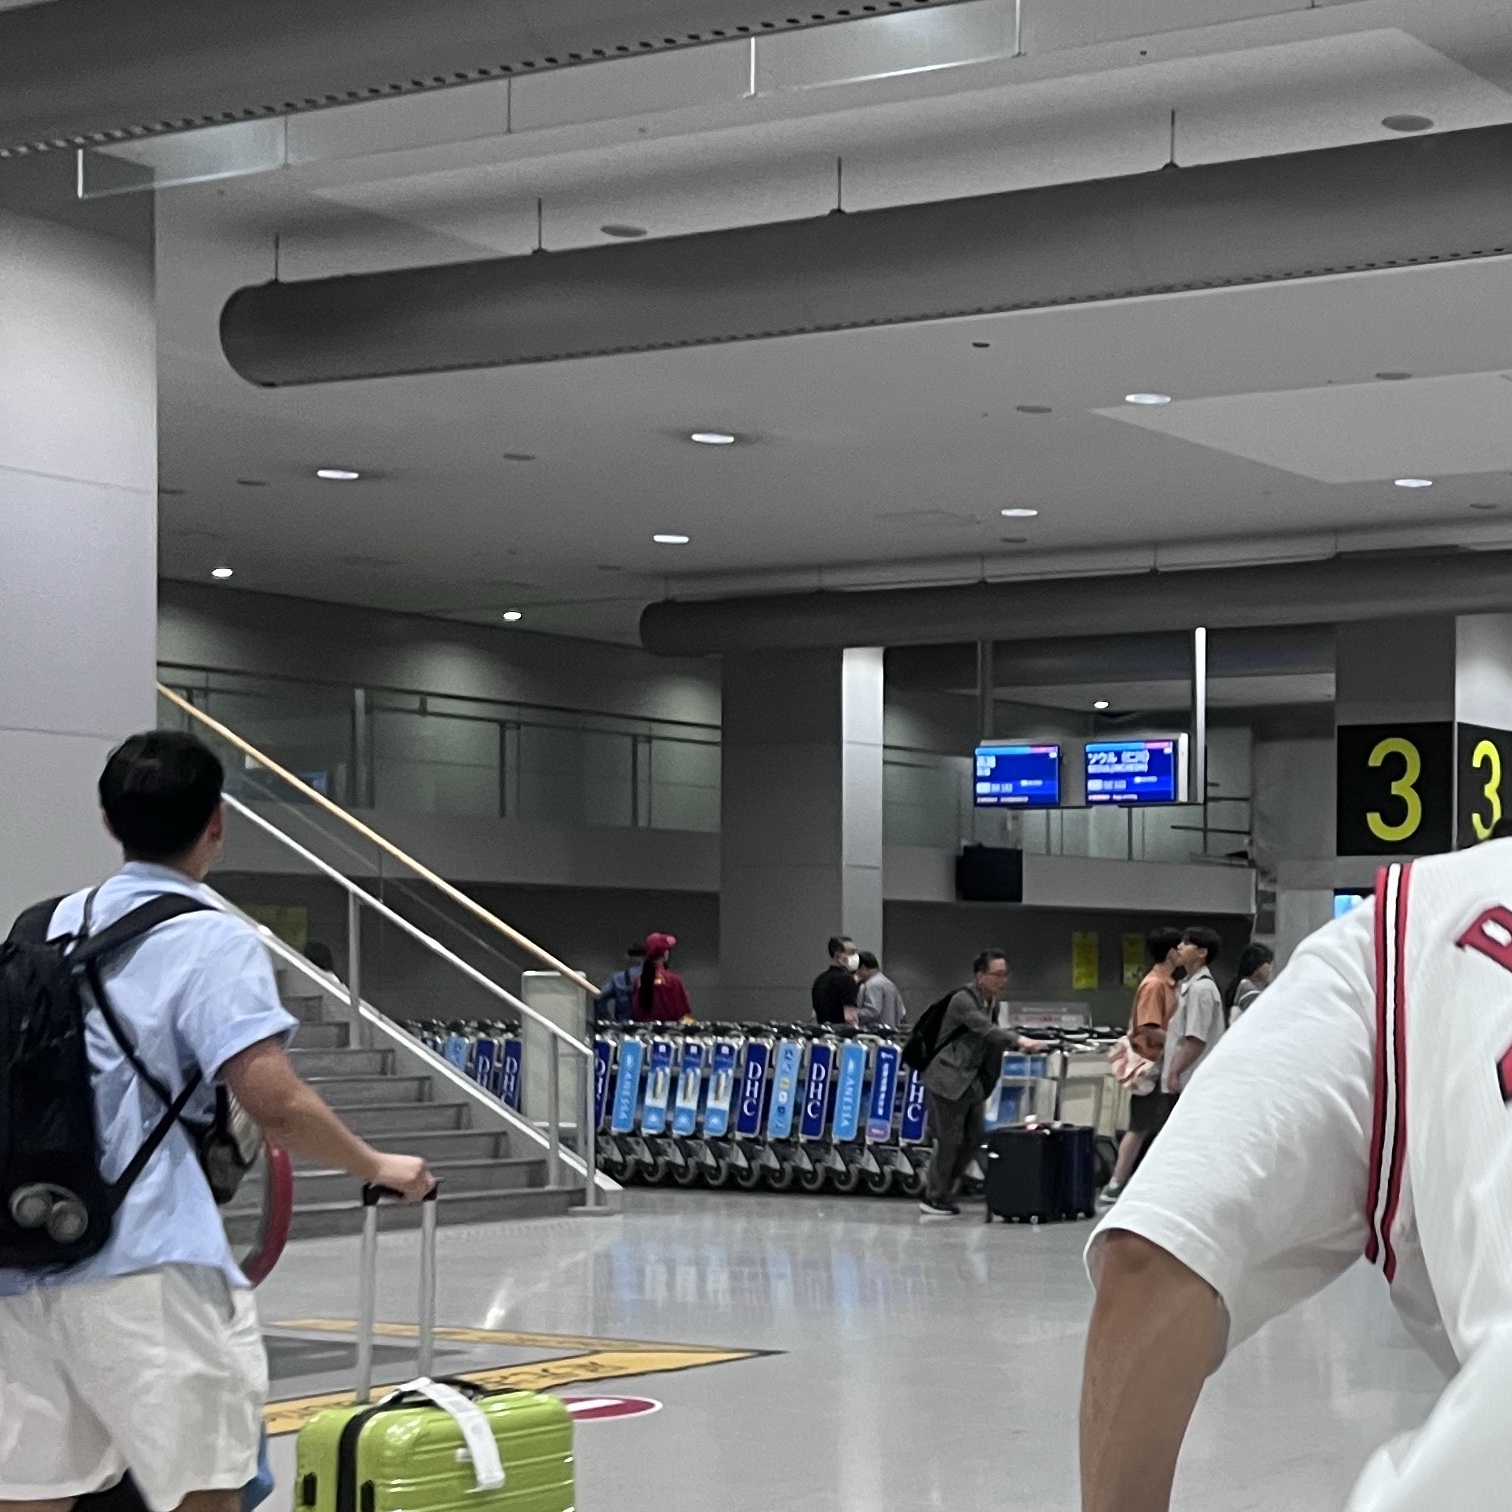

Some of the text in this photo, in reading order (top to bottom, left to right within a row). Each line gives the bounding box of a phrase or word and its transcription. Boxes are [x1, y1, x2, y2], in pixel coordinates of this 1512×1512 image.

[1366, 737, 1422, 841] 3
[1472, 740, 1502, 840] 3
[743, 1061, 762, 1116] DHC
[807, 1062, 826, 1118] DHC
